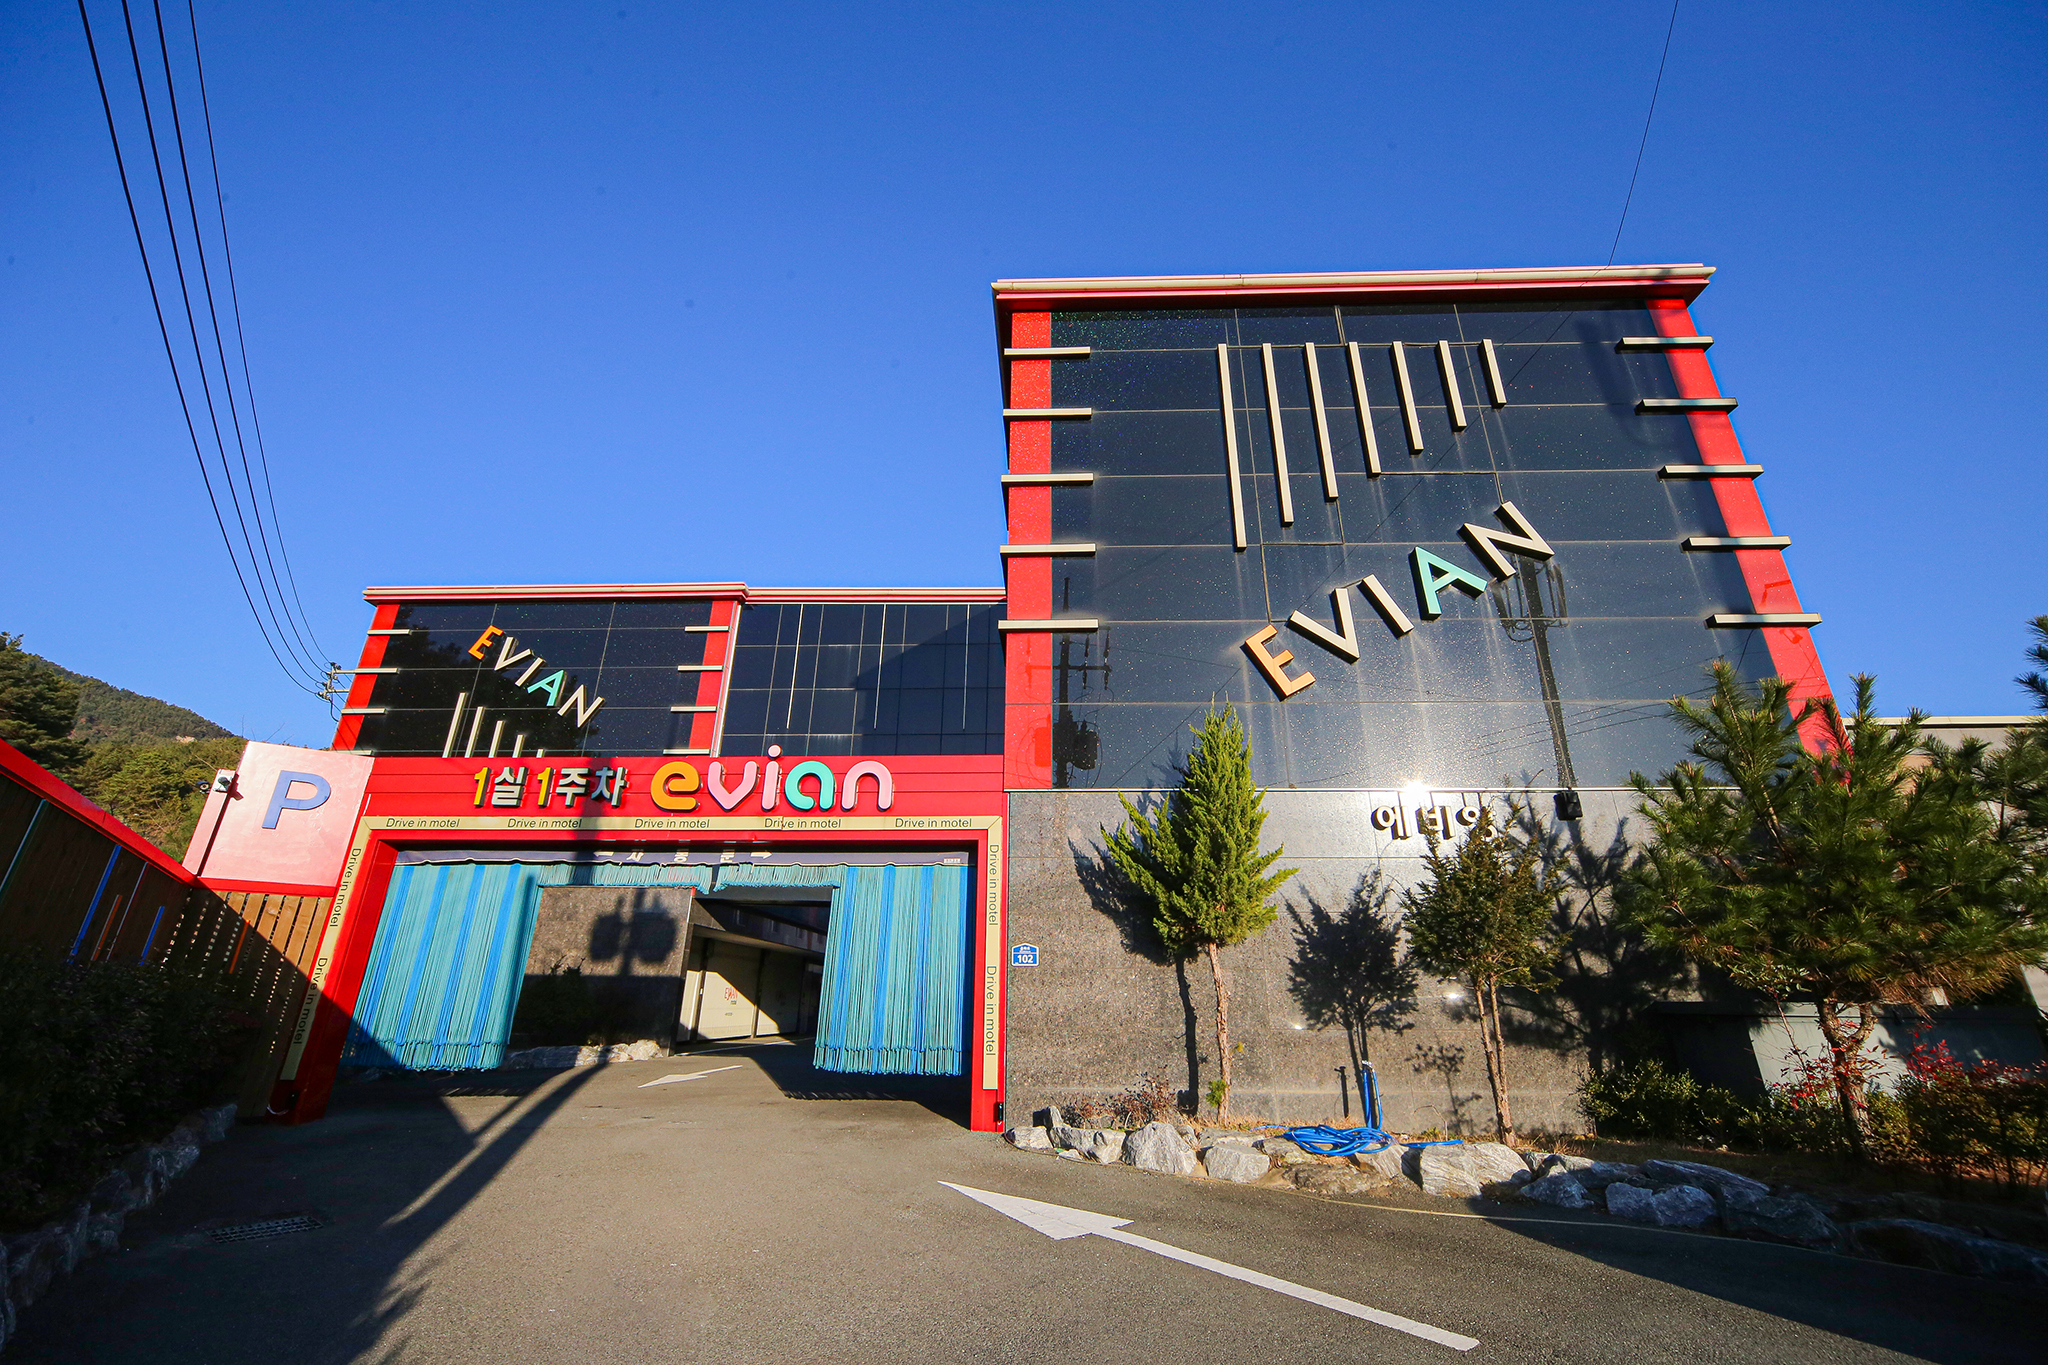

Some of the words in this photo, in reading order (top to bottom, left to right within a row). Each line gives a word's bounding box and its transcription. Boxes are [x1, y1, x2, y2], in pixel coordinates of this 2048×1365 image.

[1242, 500, 1556, 701] EVIAN
[467, 624, 606, 729] EVIAN
[473, 766, 528, 807] 1실
[536, 766, 627, 807] 1주차
[650, 744, 894, 812] evian
[261, 770, 331, 829] P
[385, 817, 415, 828] Drive
[416, 817, 427, 828] in
[429, 817, 461, 828] motel
[507, 818, 537, 828] Drive
[538, 818, 549, 828] in
[550, 818, 583, 828] motel
[634, 818, 663, 829] Drive
[665, 818, 678, 829] in
[680, 818, 710, 829] motel
[764, 818, 795, 829] Drive
[797, 818, 808, 829] in
[811, 818, 842, 829] motel
[895, 818, 926, 828] Drive
[928, 818, 938, 828] in
[941, 818, 973, 828] motel
[344, 848, 362, 878] Drive
[989, 844, 1000, 876] Drive
[339, 881, 352, 891] in
[989, 879, 998, 891] in
[329, 893, 346, 927] motel
[988, 893, 998, 926] motel
[309, 957, 328, 990] Drive
[1017, 954, 1034, 963] 102
[307, 991, 321, 1004] in
[986, 965, 997, 1000] Drive
[986, 1003, 996, 1016] in
[293, 1007, 312, 1045] motel
[985, 1018, 996, 1056] motel
